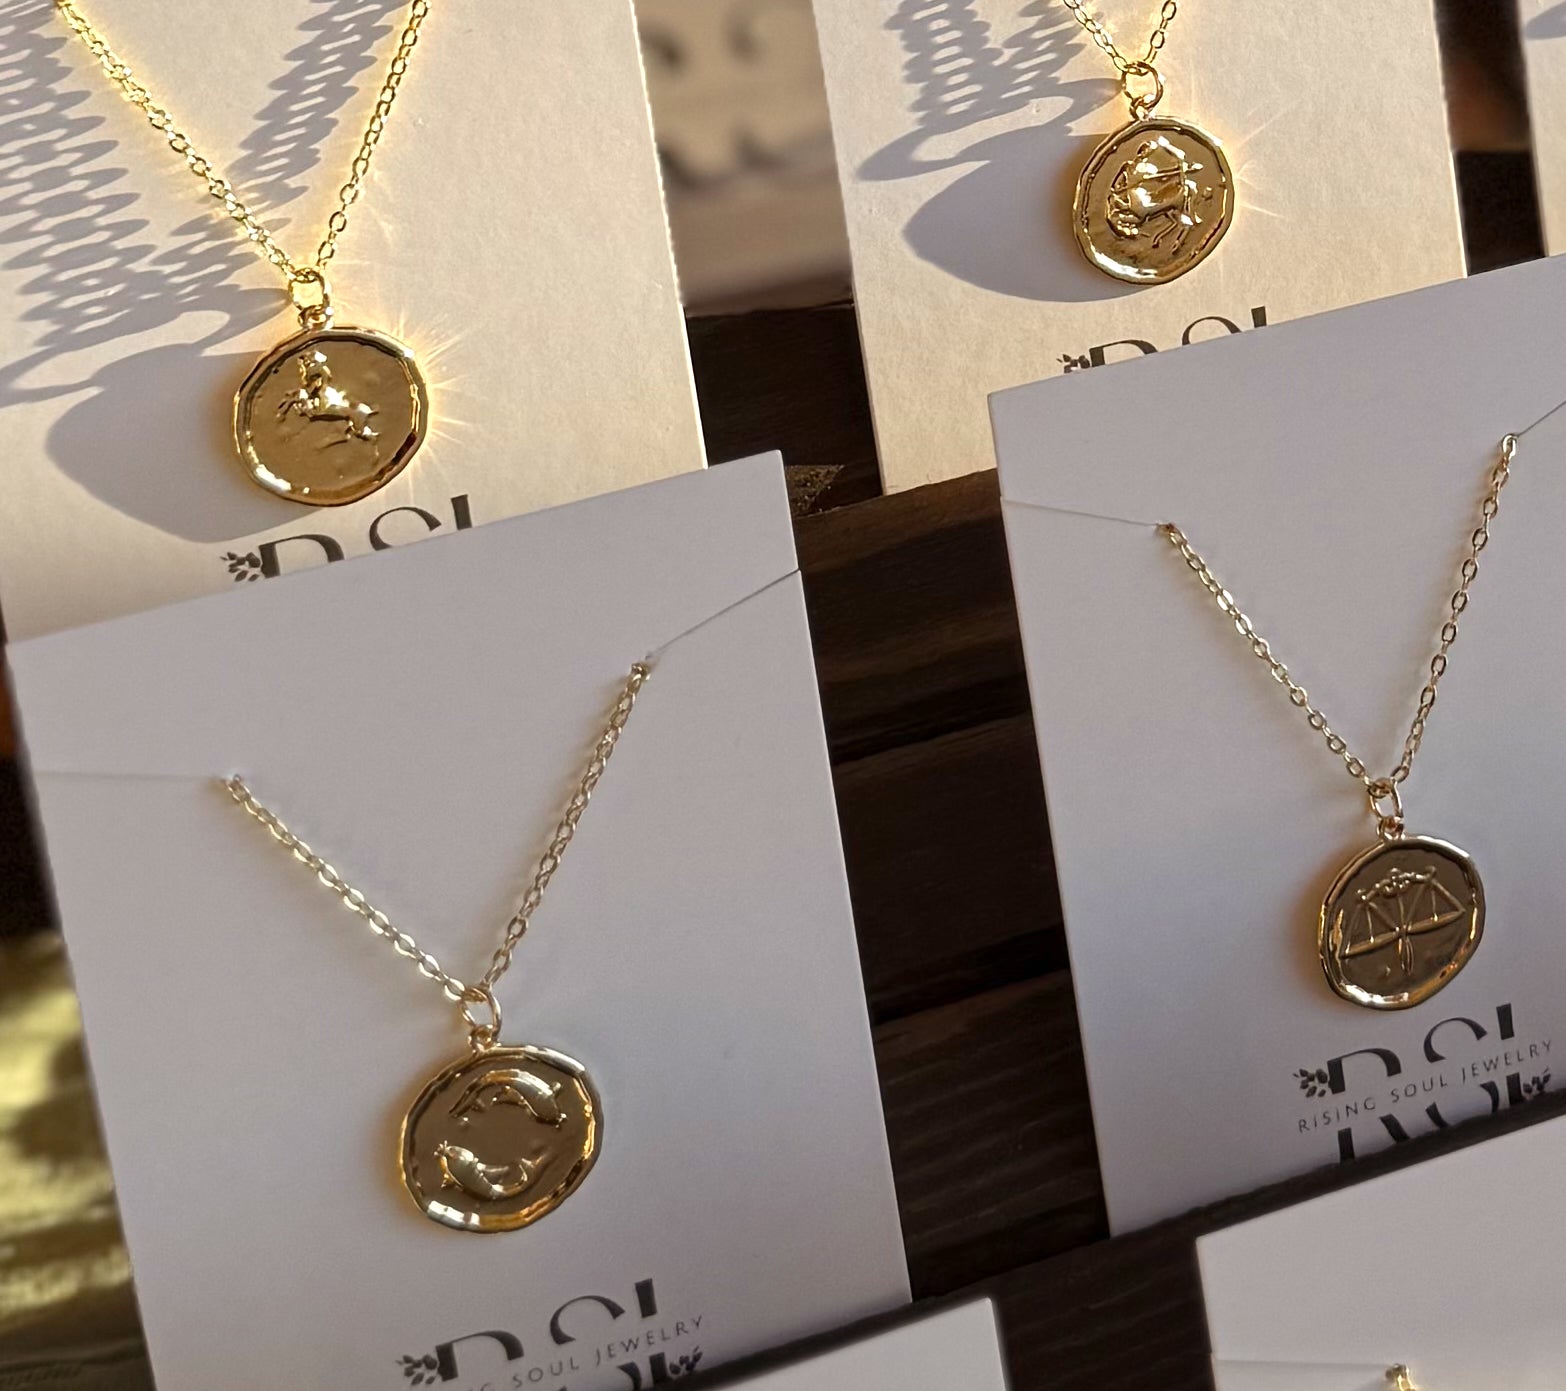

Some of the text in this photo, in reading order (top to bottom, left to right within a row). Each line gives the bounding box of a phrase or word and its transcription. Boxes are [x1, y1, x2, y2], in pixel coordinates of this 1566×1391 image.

[1299, 1040, 1552, 1133] RISING SOUL JEWELRY
[512, 1356, 580, 1388] SOUL
[596, 1315, 703, 1367] JEWELRY
